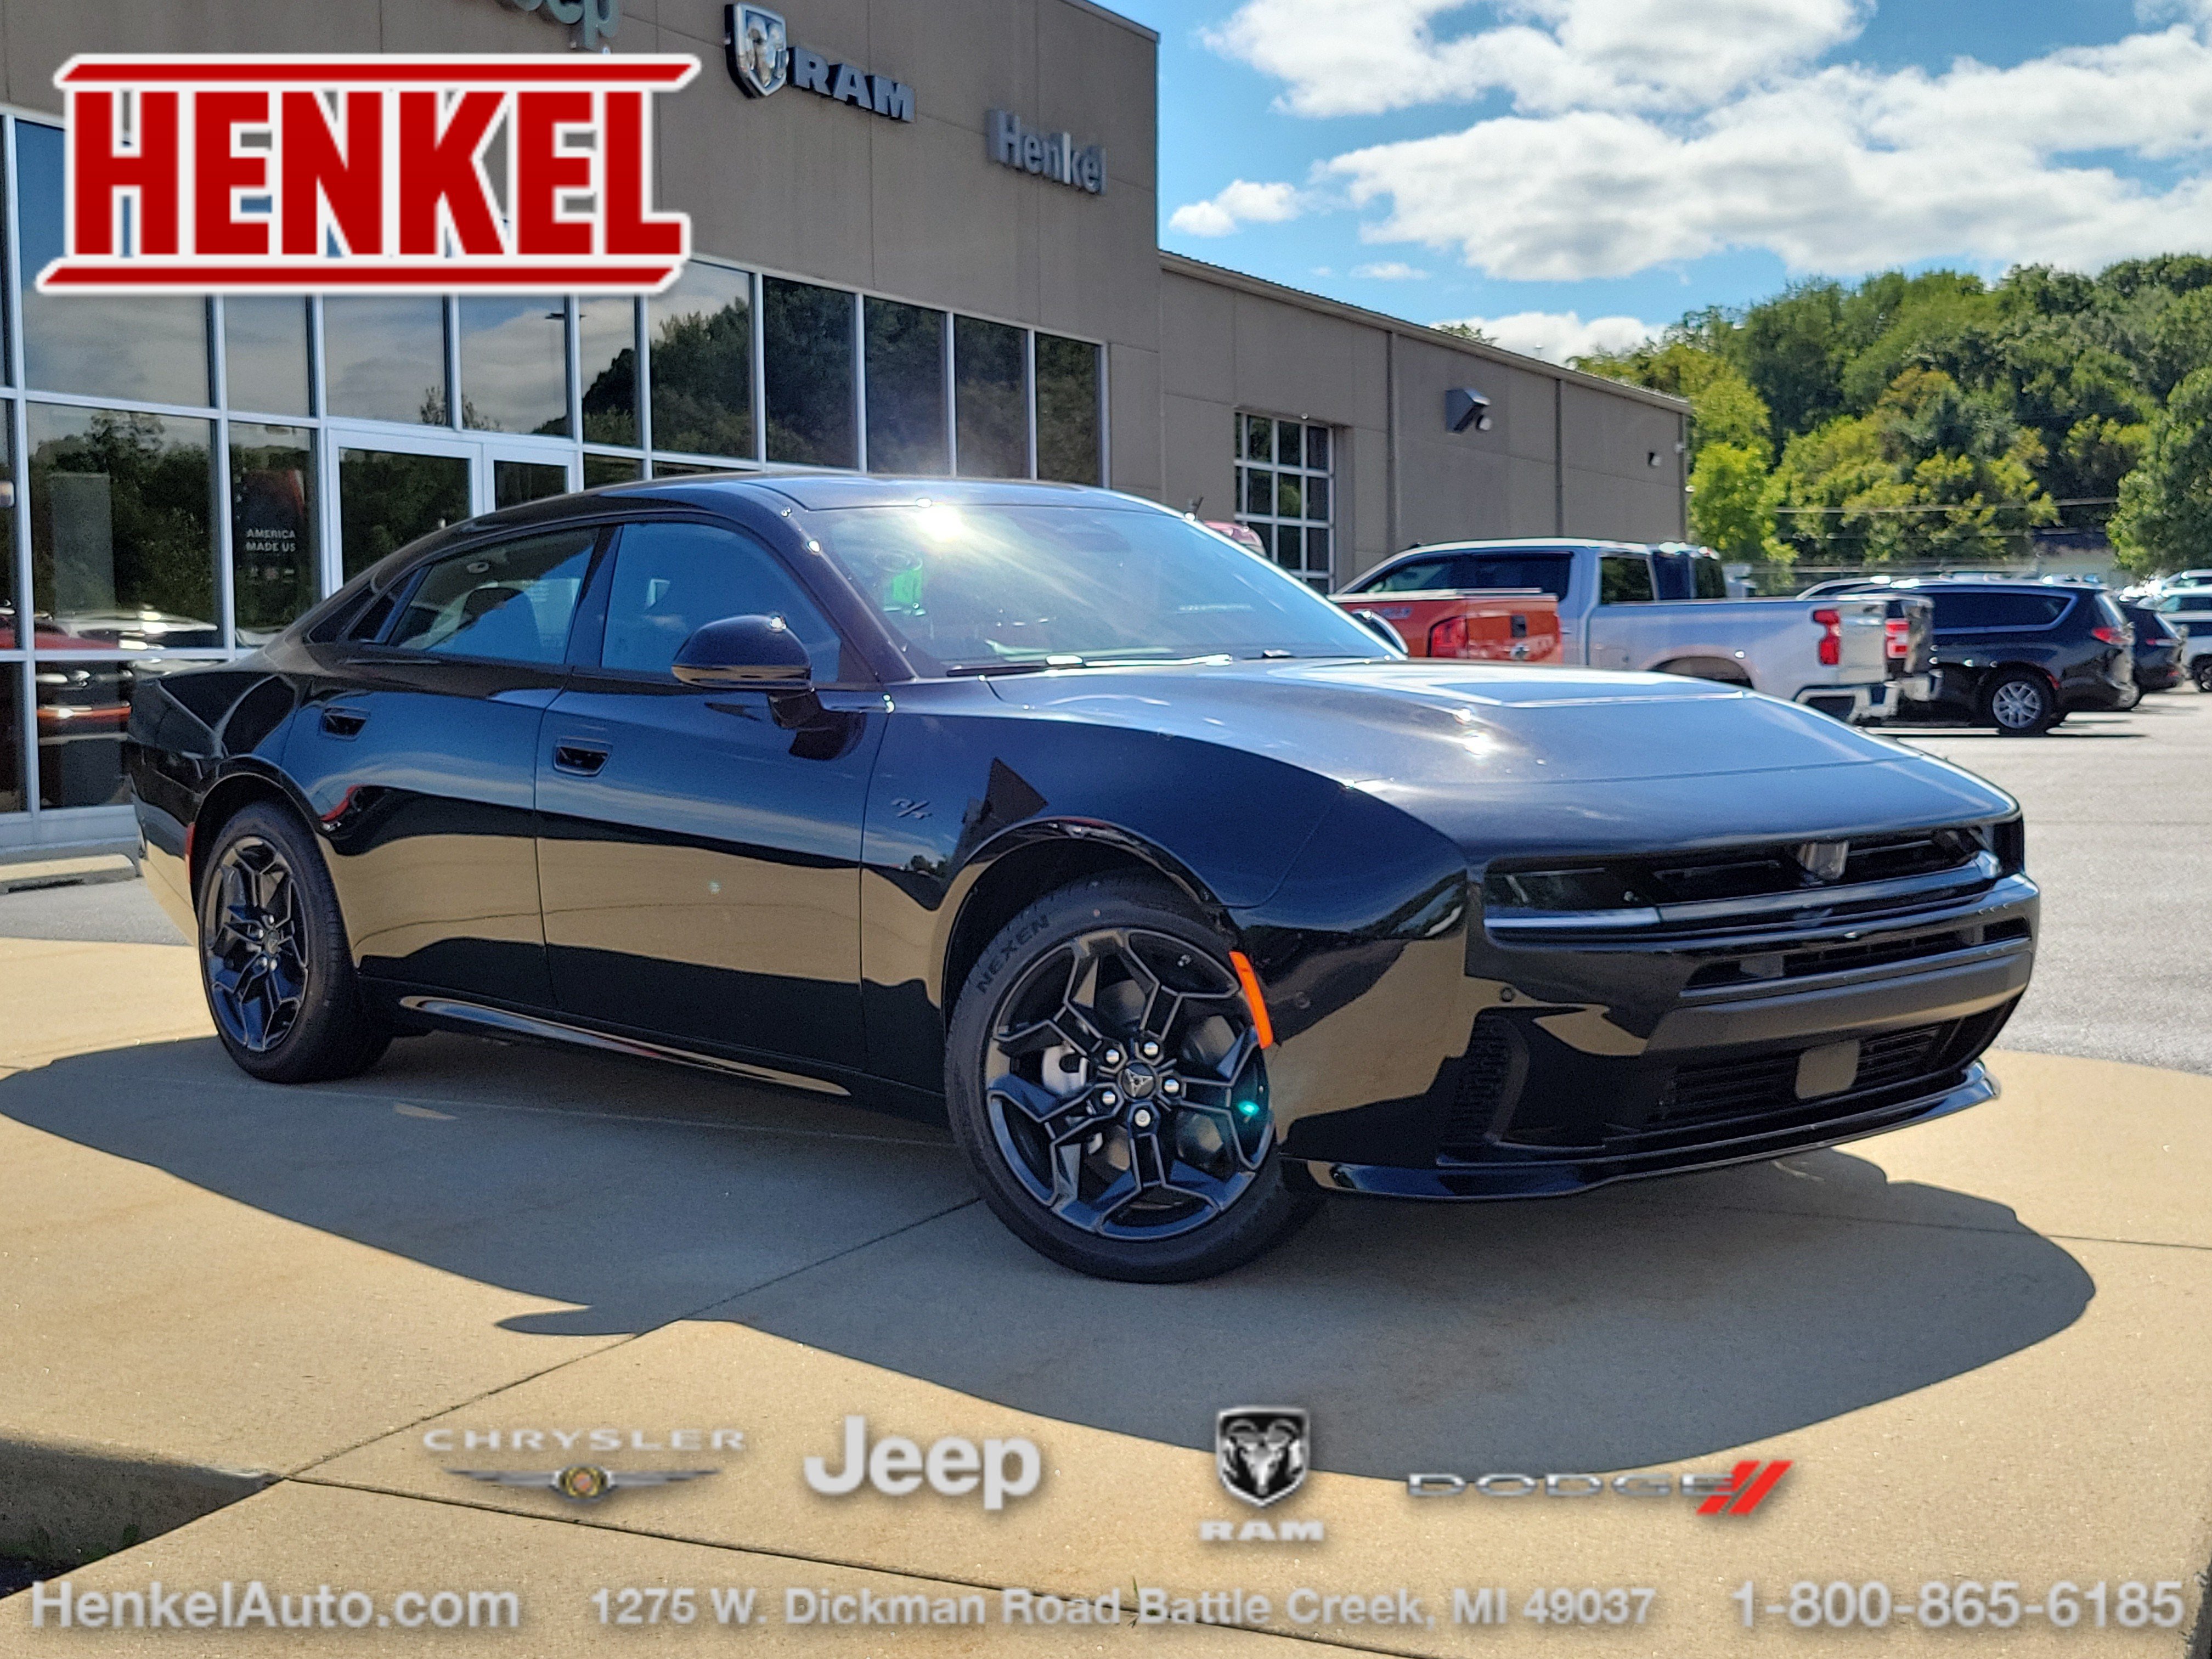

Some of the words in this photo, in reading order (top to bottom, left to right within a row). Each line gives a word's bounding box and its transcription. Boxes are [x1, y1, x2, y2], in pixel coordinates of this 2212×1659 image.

[787, 46, 915, 123] RAM
[986, 109, 1107, 195] Henkel
[245, 541, 279, 552] MADE
[281, 542, 296, 552] US
[246, 528, 296, 539] AMERICA
[976, 914, 1049, 994] NEXEN
